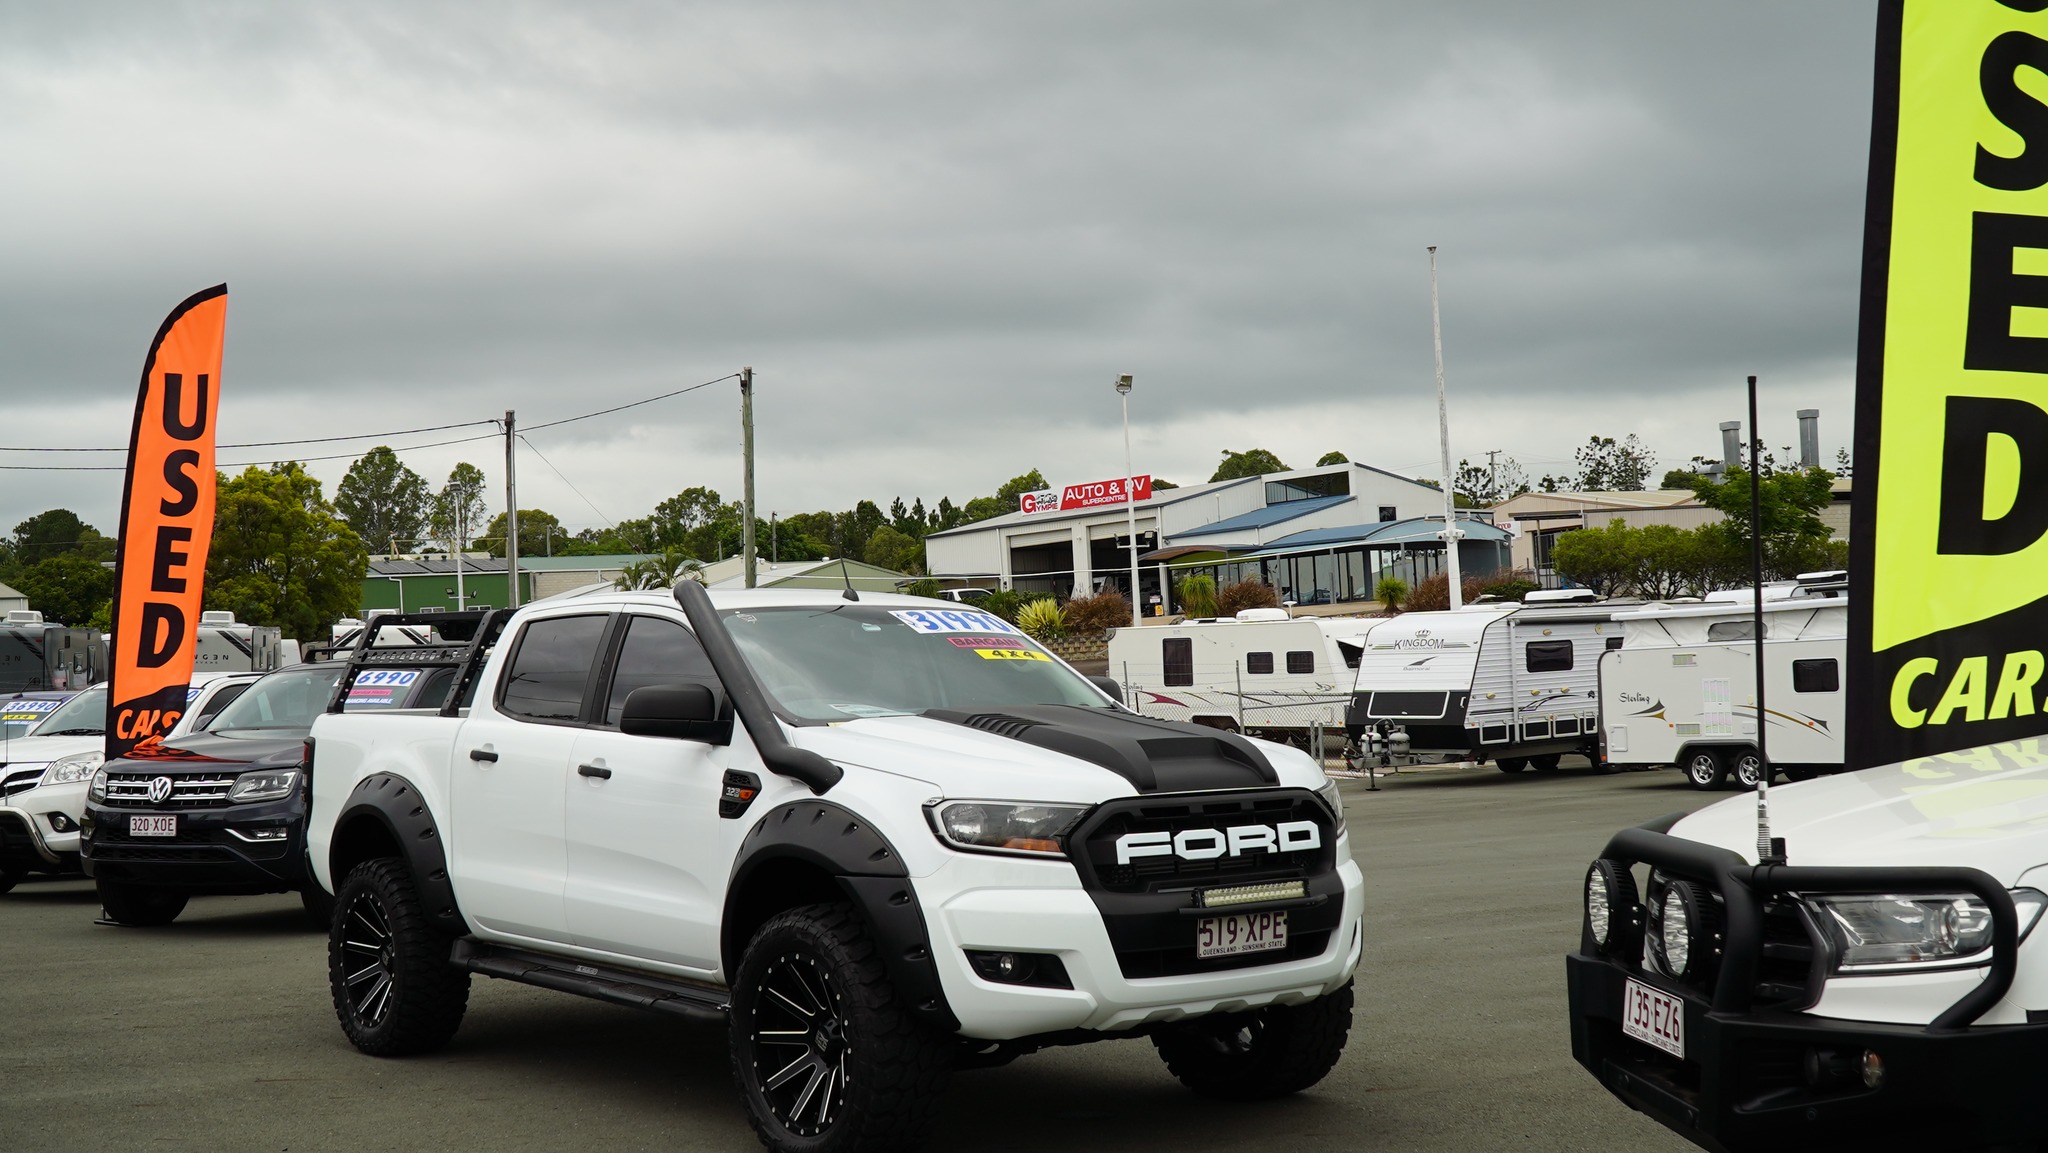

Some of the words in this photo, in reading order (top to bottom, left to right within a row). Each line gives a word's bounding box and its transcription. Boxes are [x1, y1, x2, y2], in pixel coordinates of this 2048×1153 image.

[1937, 0, 2048, 557] SED
[1065, 483, 1105, 501] AUTO
[1108, 481, 1121, 496] &
[1082, 494, 1126, 506] SUPERCENTRE
[1021, 493, 1058, 514] GYMPIE
[137, 372, 208, 669] USED
[904, 610, 1013, 633] 31990
[952, 638, 1023, 648] BARGAIN
[1393, 638, 1444, 650] KINGDOM
[356, 671, 416, 684] 6990
[1618, 692, 1650, 705] Sterling
[1890, 649, 2048, 729] CAR
[1115, 820, 1321, 865] FORD
[1202, 945, 1237, 956] QUEENSLAND
[1241, 941, 1266, 951] SUNSHINE
[1268, 940, 1283, 948] STATE
